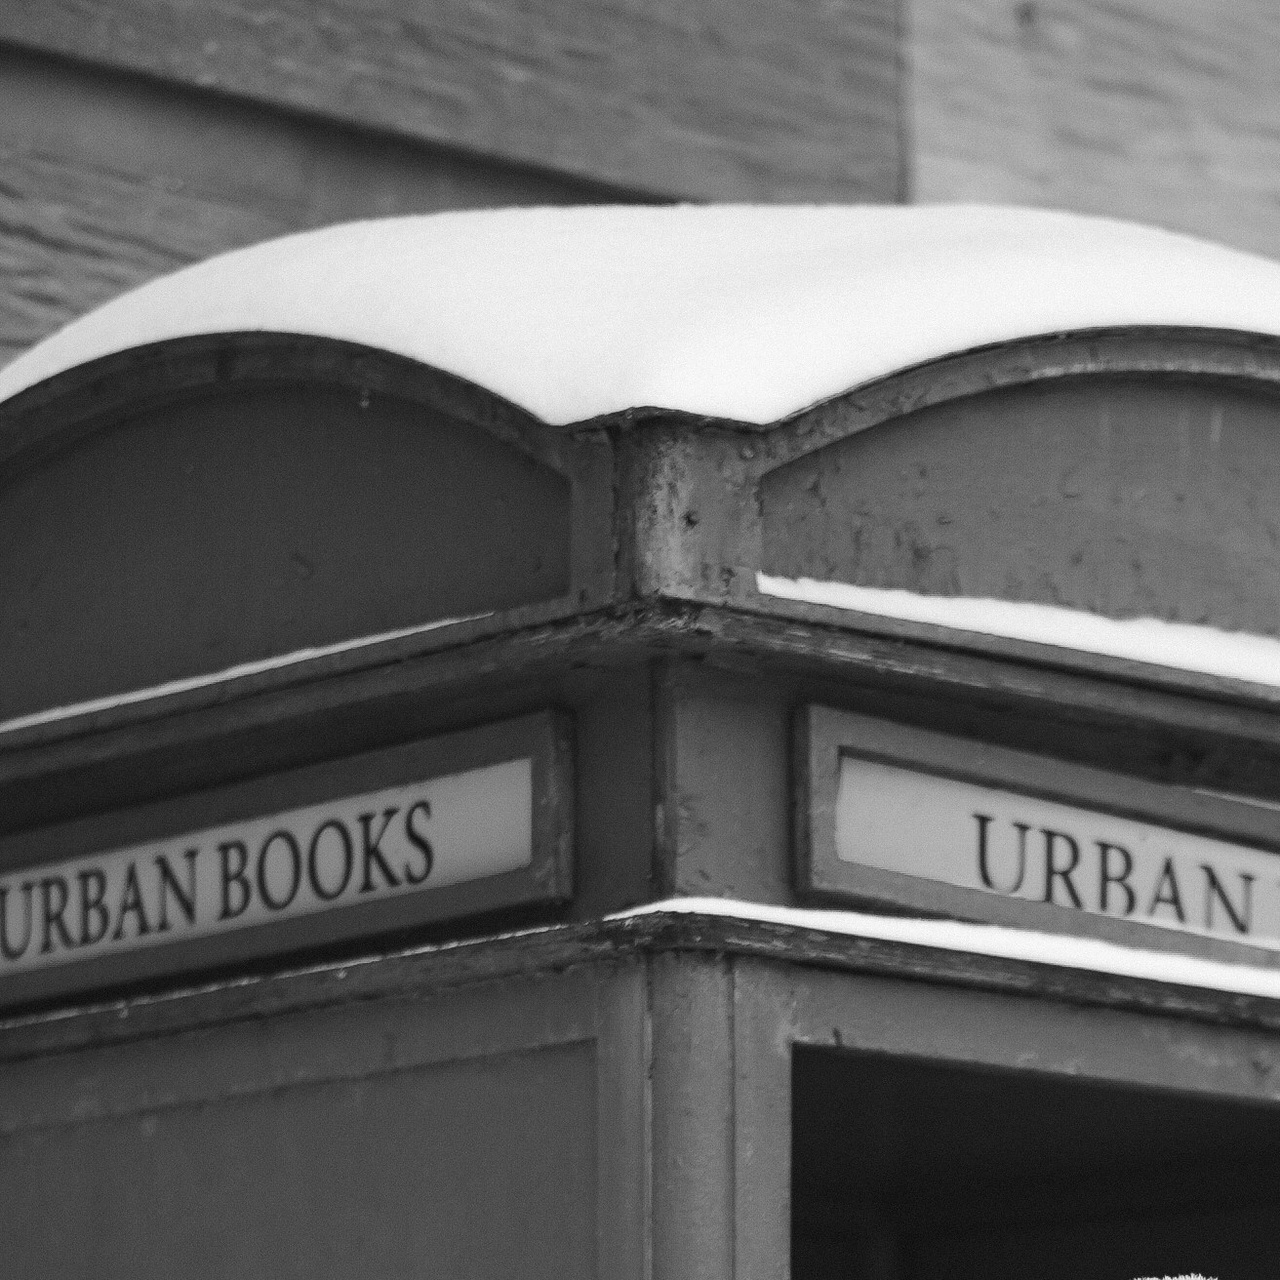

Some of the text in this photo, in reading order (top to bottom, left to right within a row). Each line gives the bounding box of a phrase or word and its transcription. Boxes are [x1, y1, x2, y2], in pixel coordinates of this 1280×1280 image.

[0, 800, 434, 961] URBAN BOOKS
[971, 812, 1254, 935] URBAN
